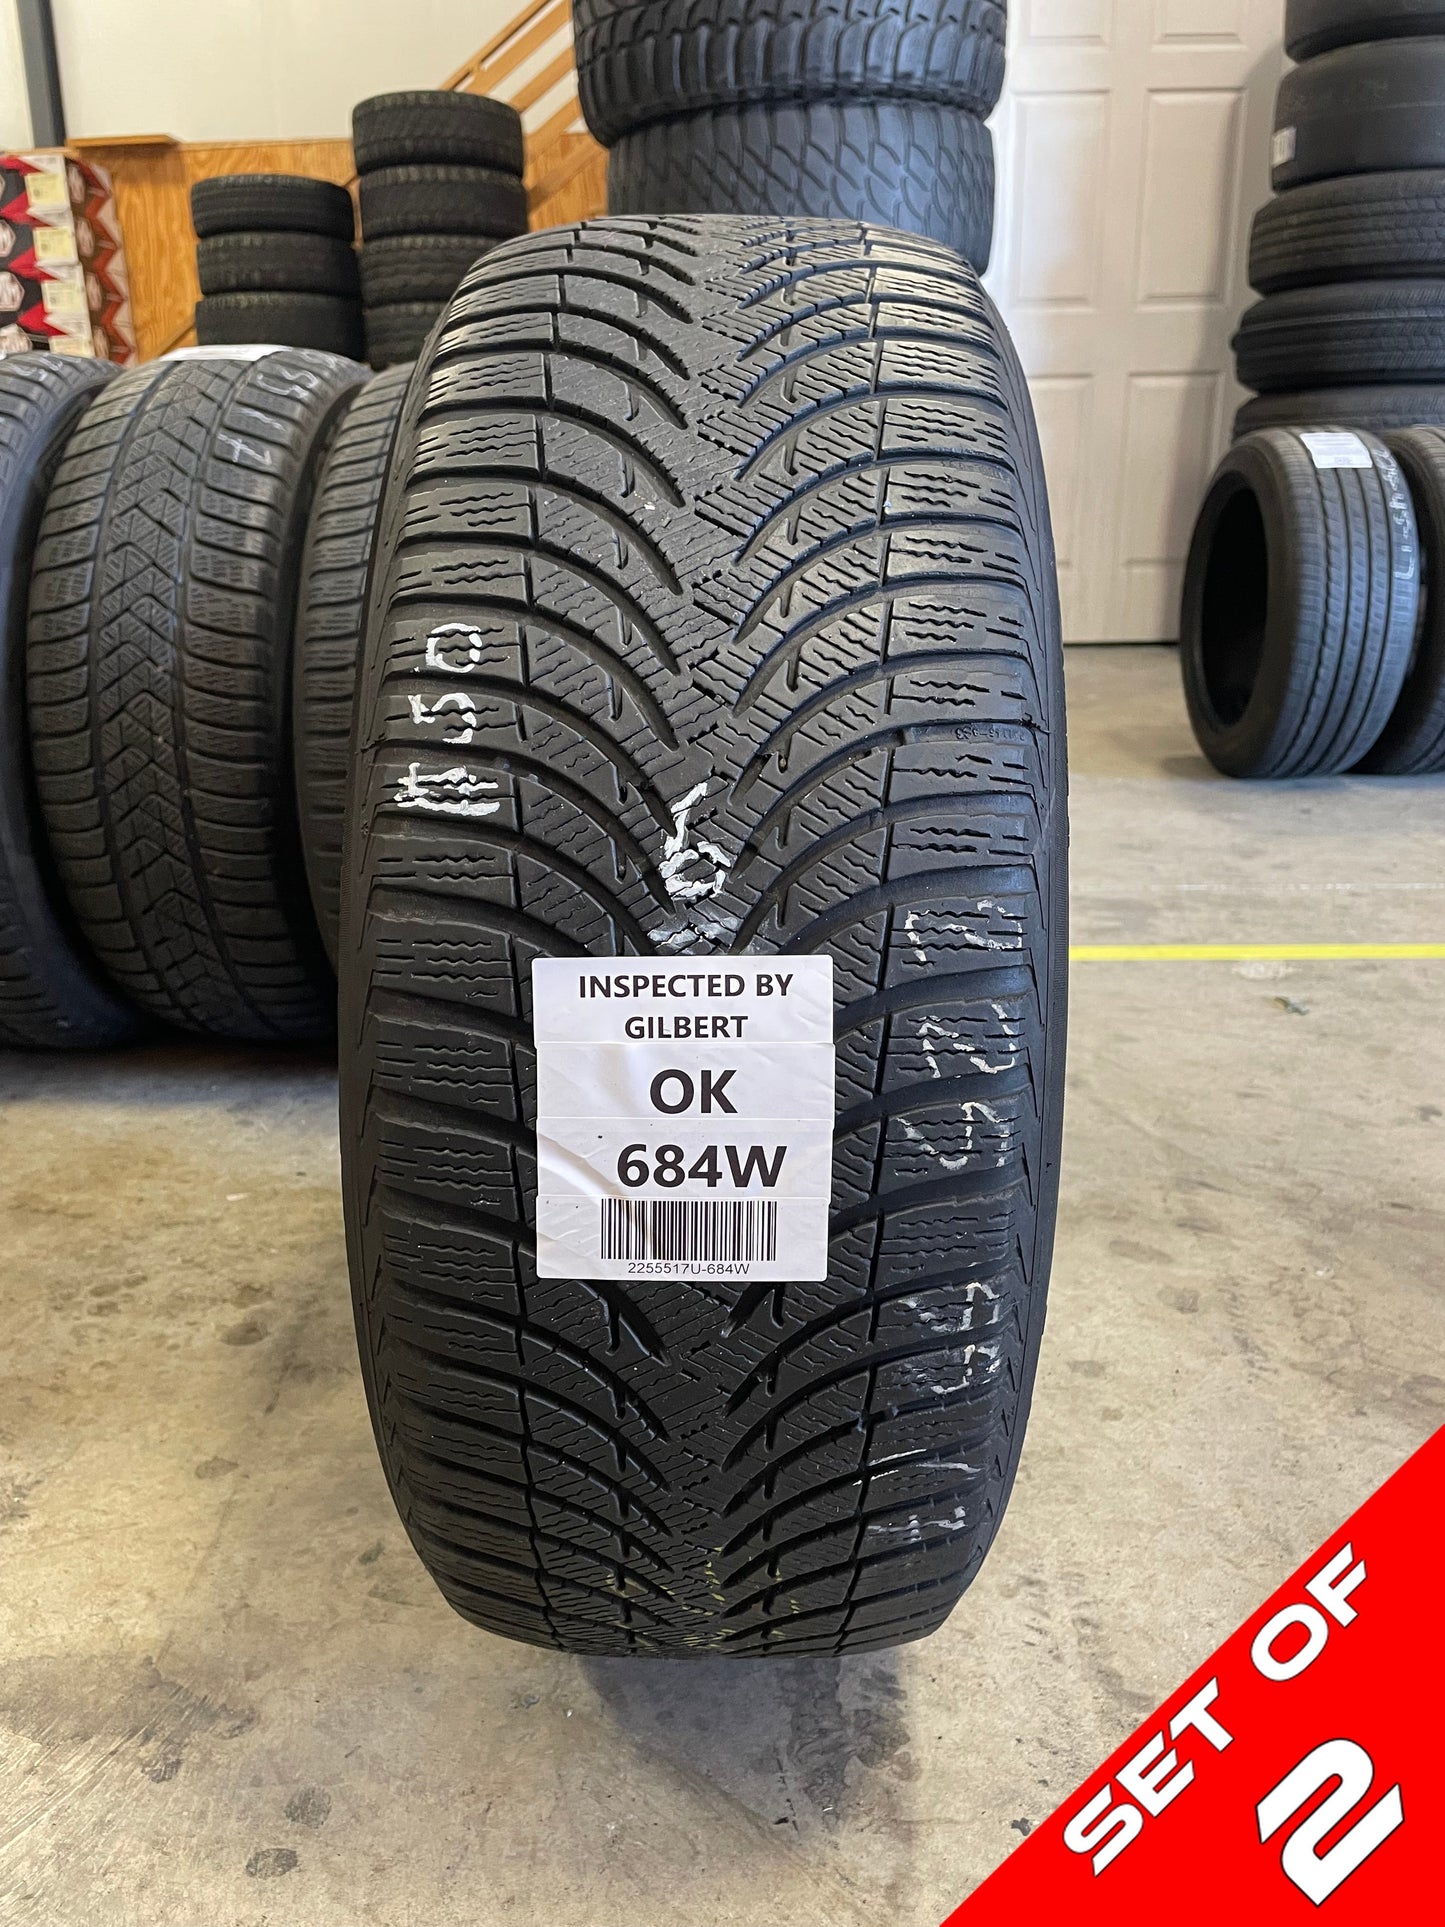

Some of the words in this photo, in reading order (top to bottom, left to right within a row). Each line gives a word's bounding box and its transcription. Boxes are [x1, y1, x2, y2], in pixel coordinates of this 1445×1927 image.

[579, 974, 745, 998] INSPECTED
[756, 973, 794, 997] BY
[624, 1015, 749, 1039] GILBERT
[649, 1068, 738, 1114] OK
[617, 1143, 787, 1188] 684W
[628, 1262, 750, 1275] 2255517U-684W
